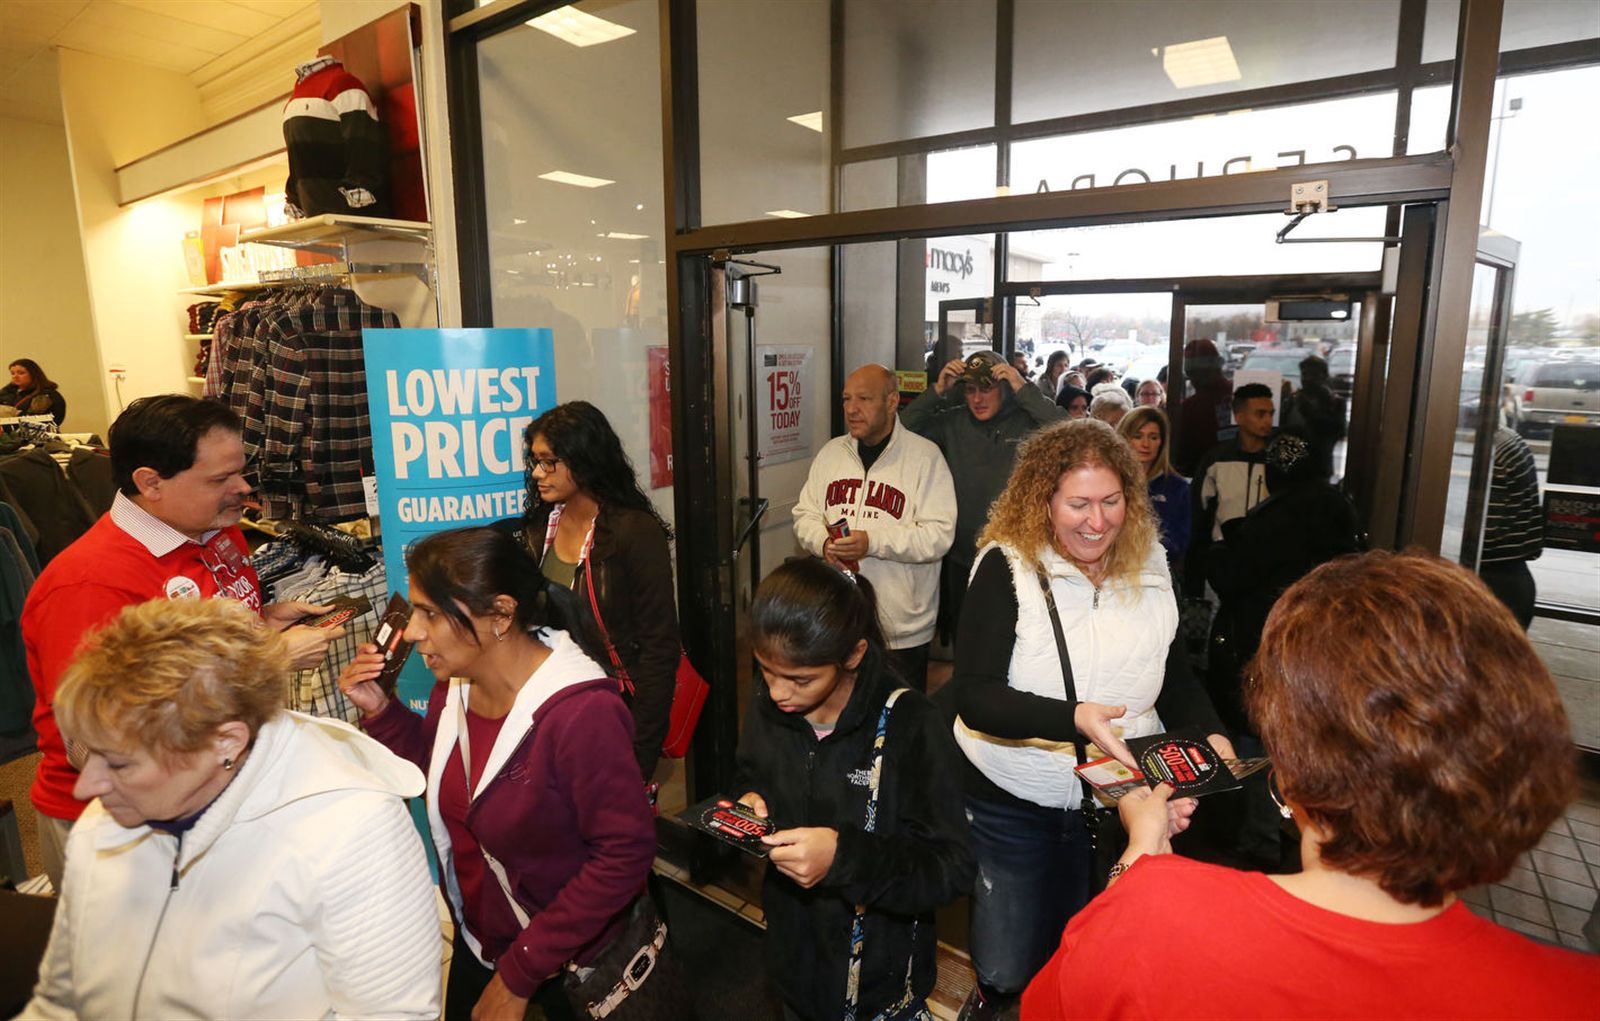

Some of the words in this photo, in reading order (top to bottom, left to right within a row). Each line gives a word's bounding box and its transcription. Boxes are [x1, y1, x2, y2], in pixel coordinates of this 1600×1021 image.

[931, 247, 974, 280] macy's
[386, 366, 540, 417] LOWEST
[789, 396, 802, 409] OFF
[770, 410, 801, 430] TODAY
[390, 416, 533, 480] PRICE
